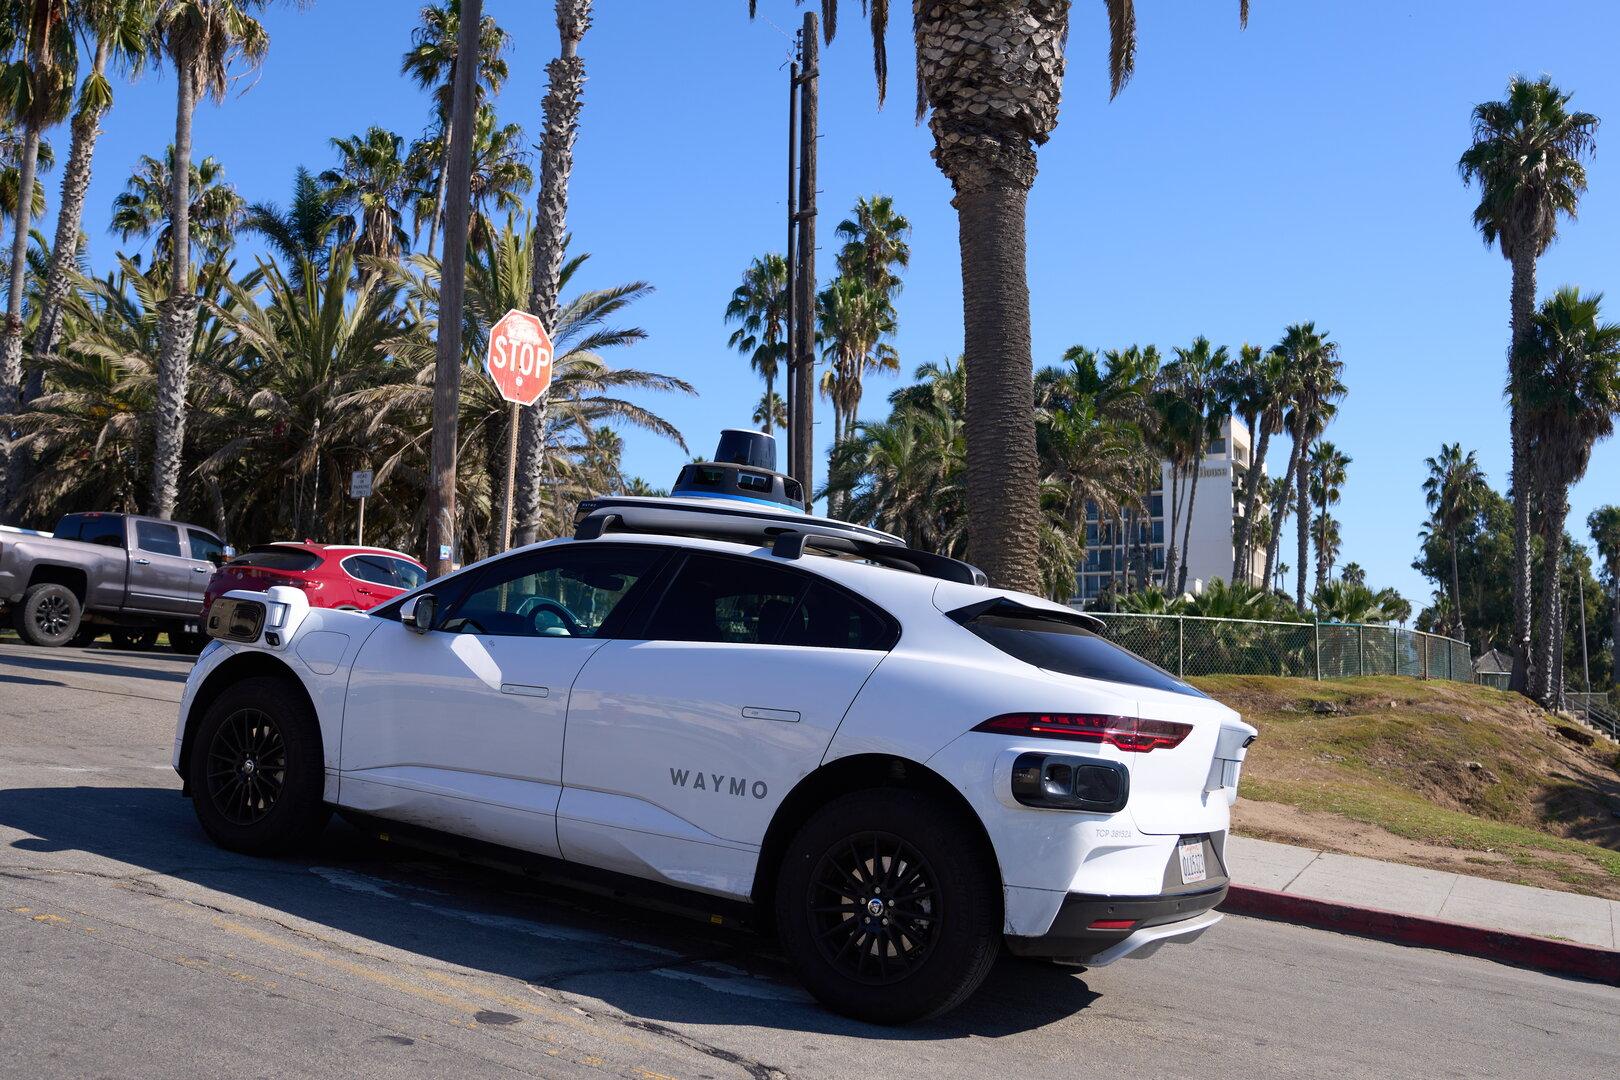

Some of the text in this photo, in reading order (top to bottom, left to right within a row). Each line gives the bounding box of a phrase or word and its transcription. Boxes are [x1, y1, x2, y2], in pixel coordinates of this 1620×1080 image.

[493, 335, 550, 378] STOP
[670, 767, 768, 800] WAYMO
[1095, 829, 1109, 838] TCP
